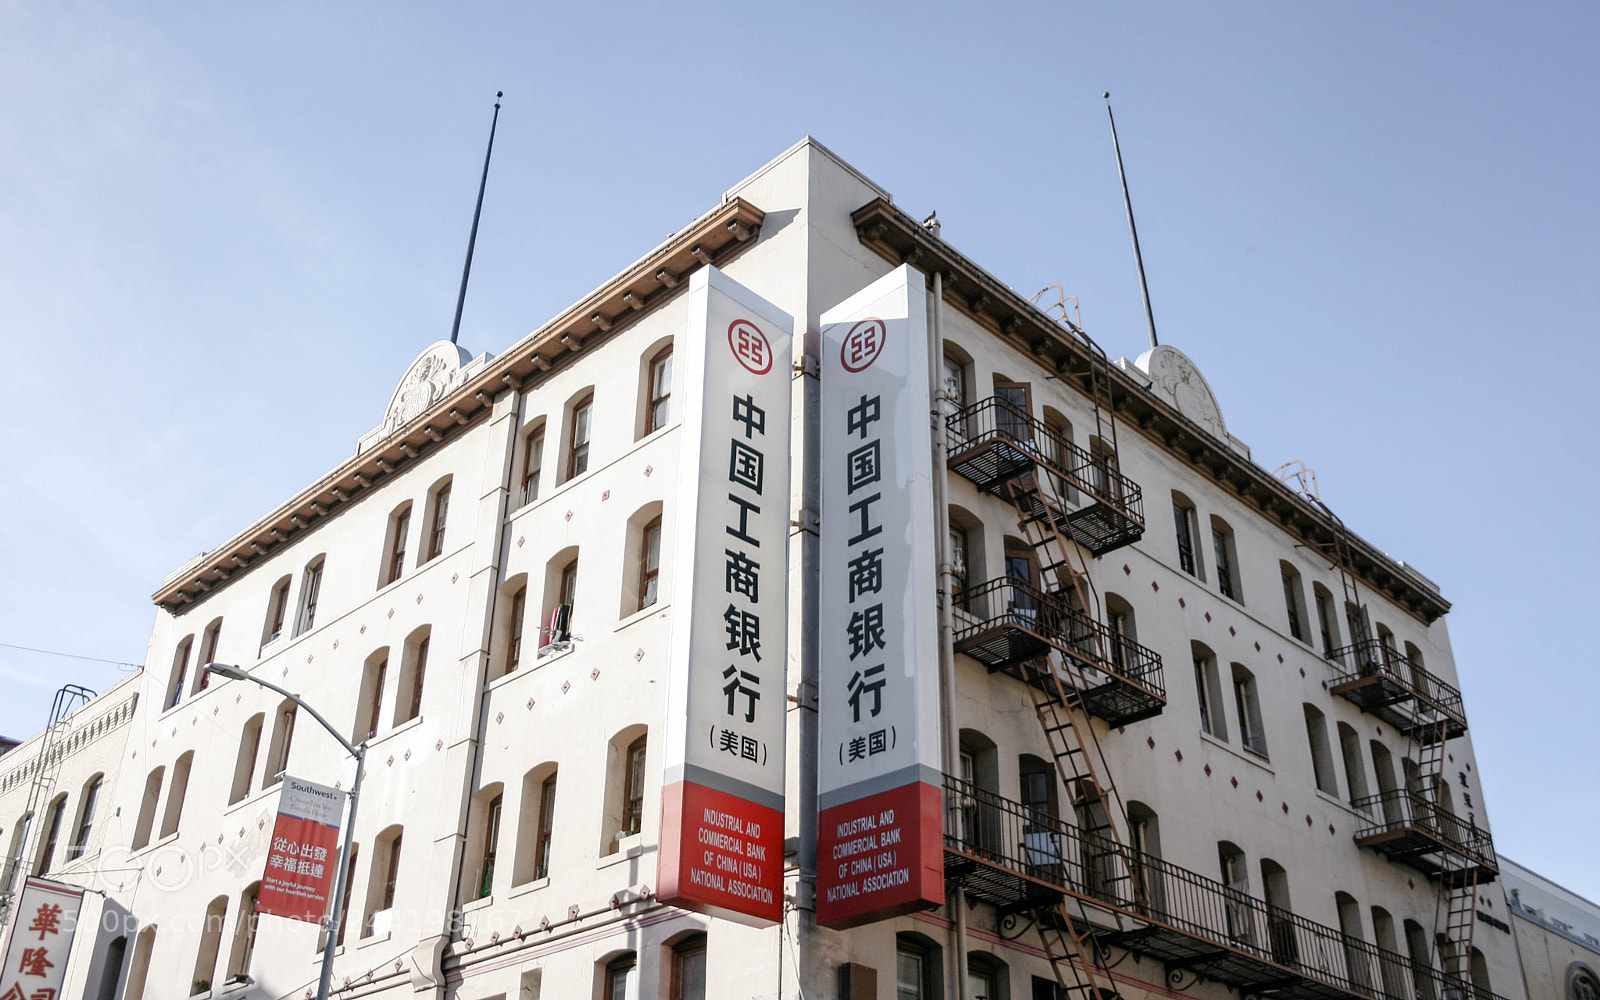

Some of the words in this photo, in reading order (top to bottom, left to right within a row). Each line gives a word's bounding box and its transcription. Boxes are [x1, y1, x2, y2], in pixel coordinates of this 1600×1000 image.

[722, 394, 766, 723] 中国工商银行
[846, 394, 887, 723] 中国工商银行
[291, 781, 333, 800] Southwest
[704, 808, 744, 834] INDUSTRIAL
[746, 822, 761, 839] AND
[837, 815, 877, 838] INDUSTRIAL
[879, 809, 895, 827] AND
[273, 836, 328, 862] 從心出發
[698, 827, 744, 855] COMMERCIAL
[746, 842, 766, 861] BANK
[704, 850, 714, 866] OF
[833, 835, 878, 860] COMMERCIAL
[881, 828, 901, 847] BANK
[269, 854, 325, 879] 幸福抵達
[838, 863, 848, 879] OF
[265, 876, 278, 884] Start
[282, 880, 297, 888] joyful
[296, 883, 316, 893] journey
[691, 868, 726, 892] NATIONAL
[727, 879, 773, 904] ASSOCIATION
[827, 881, 861, 903] NATIONAL
[862, 868, 909, 894] ASSOCIATION
[19, 903, 62, 978] 華隆
